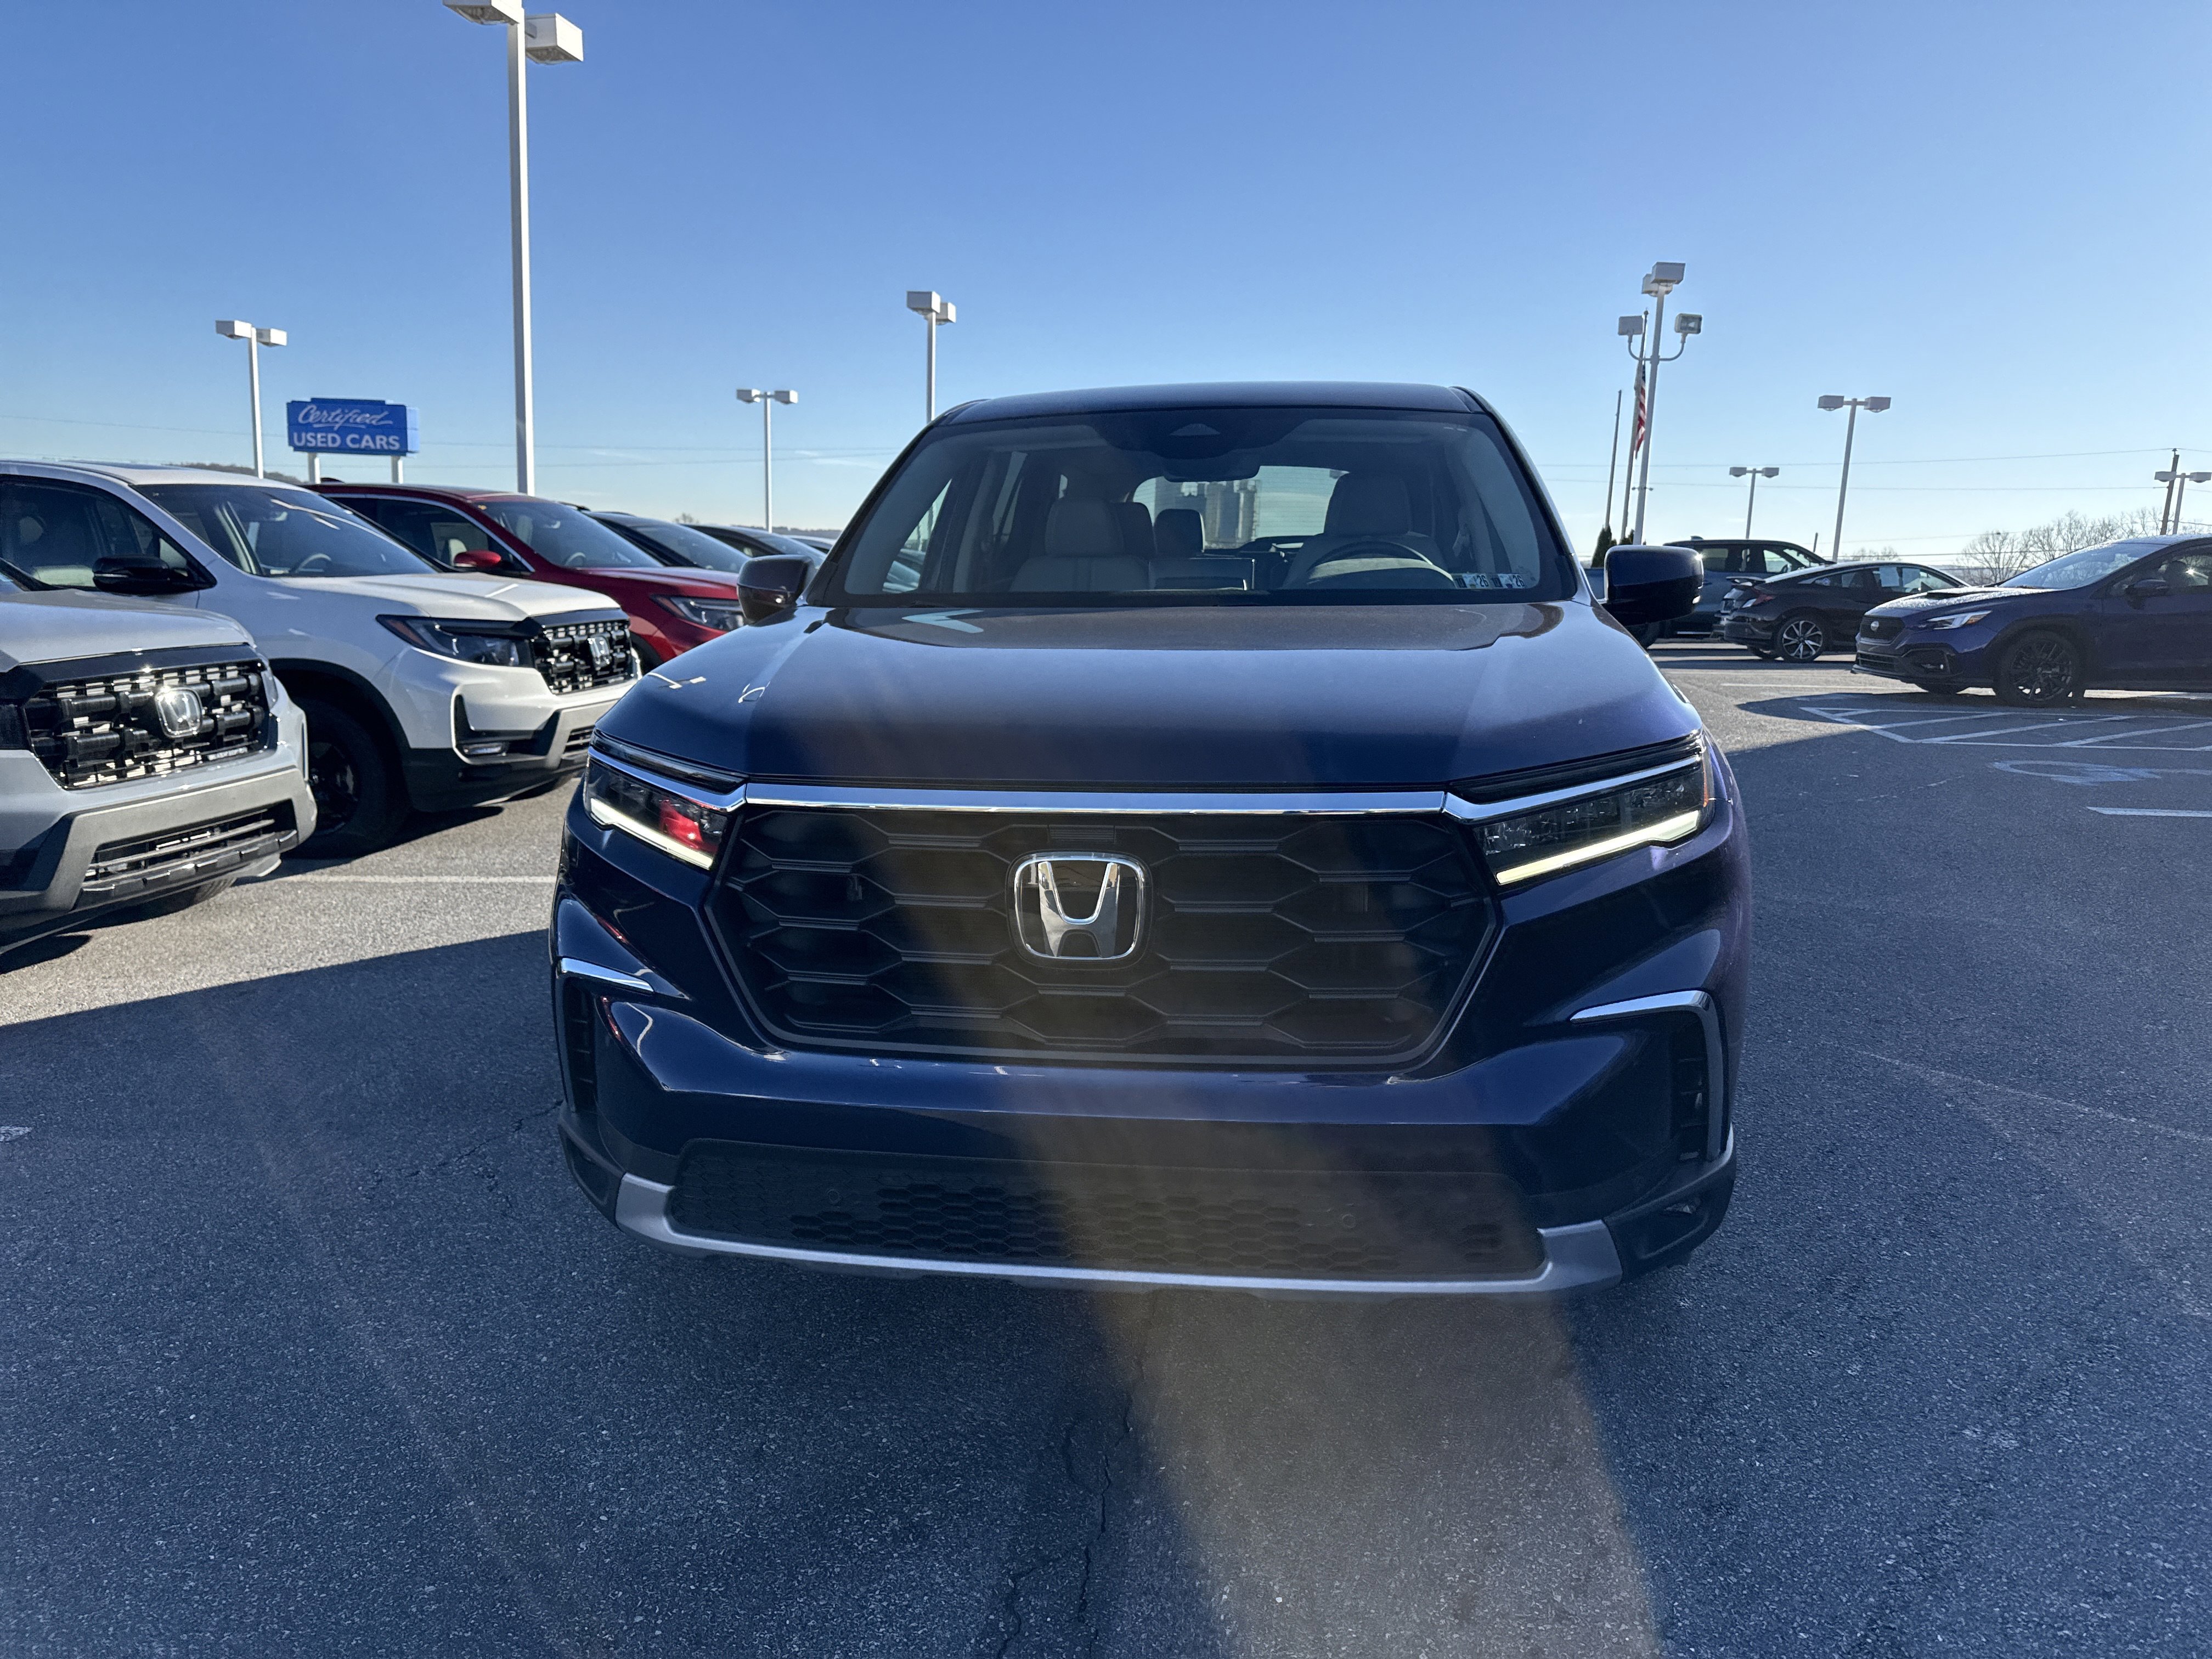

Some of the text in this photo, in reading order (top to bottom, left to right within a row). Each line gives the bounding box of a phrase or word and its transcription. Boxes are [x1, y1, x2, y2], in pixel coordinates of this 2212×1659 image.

[298, 404, 393, 431] Certified
[293, 432, 400, 450] USED CARS
[1477, 575, 1489, 587] 26
[1513, 575, 1525, 587] 26
